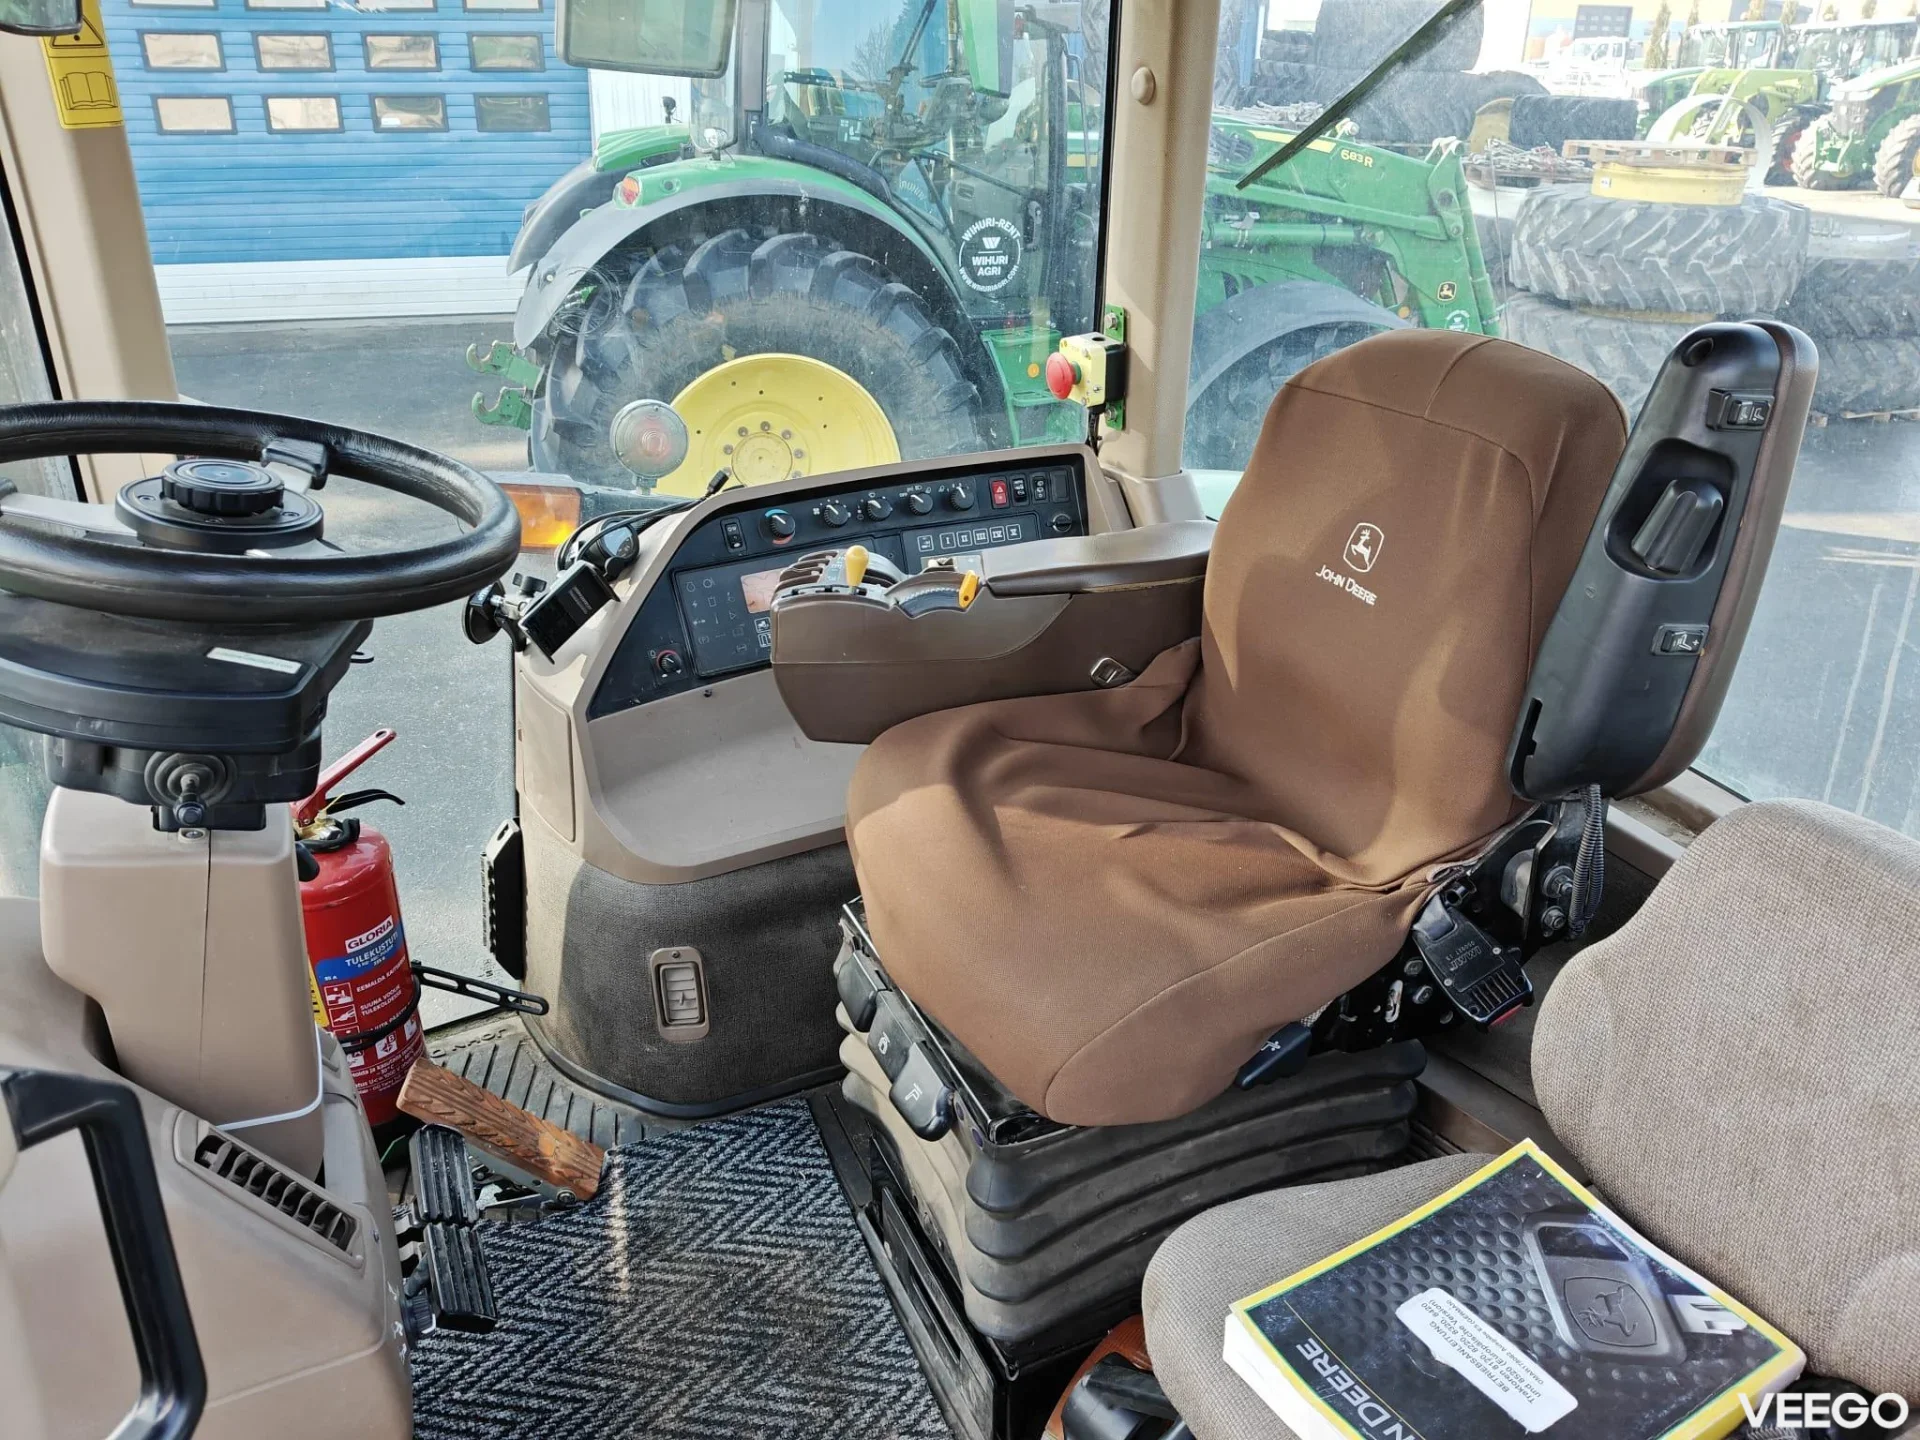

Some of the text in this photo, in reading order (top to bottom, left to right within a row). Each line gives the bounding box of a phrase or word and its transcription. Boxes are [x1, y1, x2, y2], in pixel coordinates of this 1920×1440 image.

[962, 217, 1021, 242] WIHURI-RENT
[972, 255, 1008, 265] WIHURI
[977, 267, 1001, 276] AGRI
[1315, 564, 1378, 605] JOHN DEERE
[347, 920, 392, 948] GLORIA
[1430, 1322, 1508, 1392] BETRIEBSANLEITUNG
[1296, 1338, 1392, 1428] DEERE
[1500, 1370, 1534, 1403] Traktoren
[1506, 1367, 1524, 1383] 8520
[1524, 1384, 1541, 1397] und
